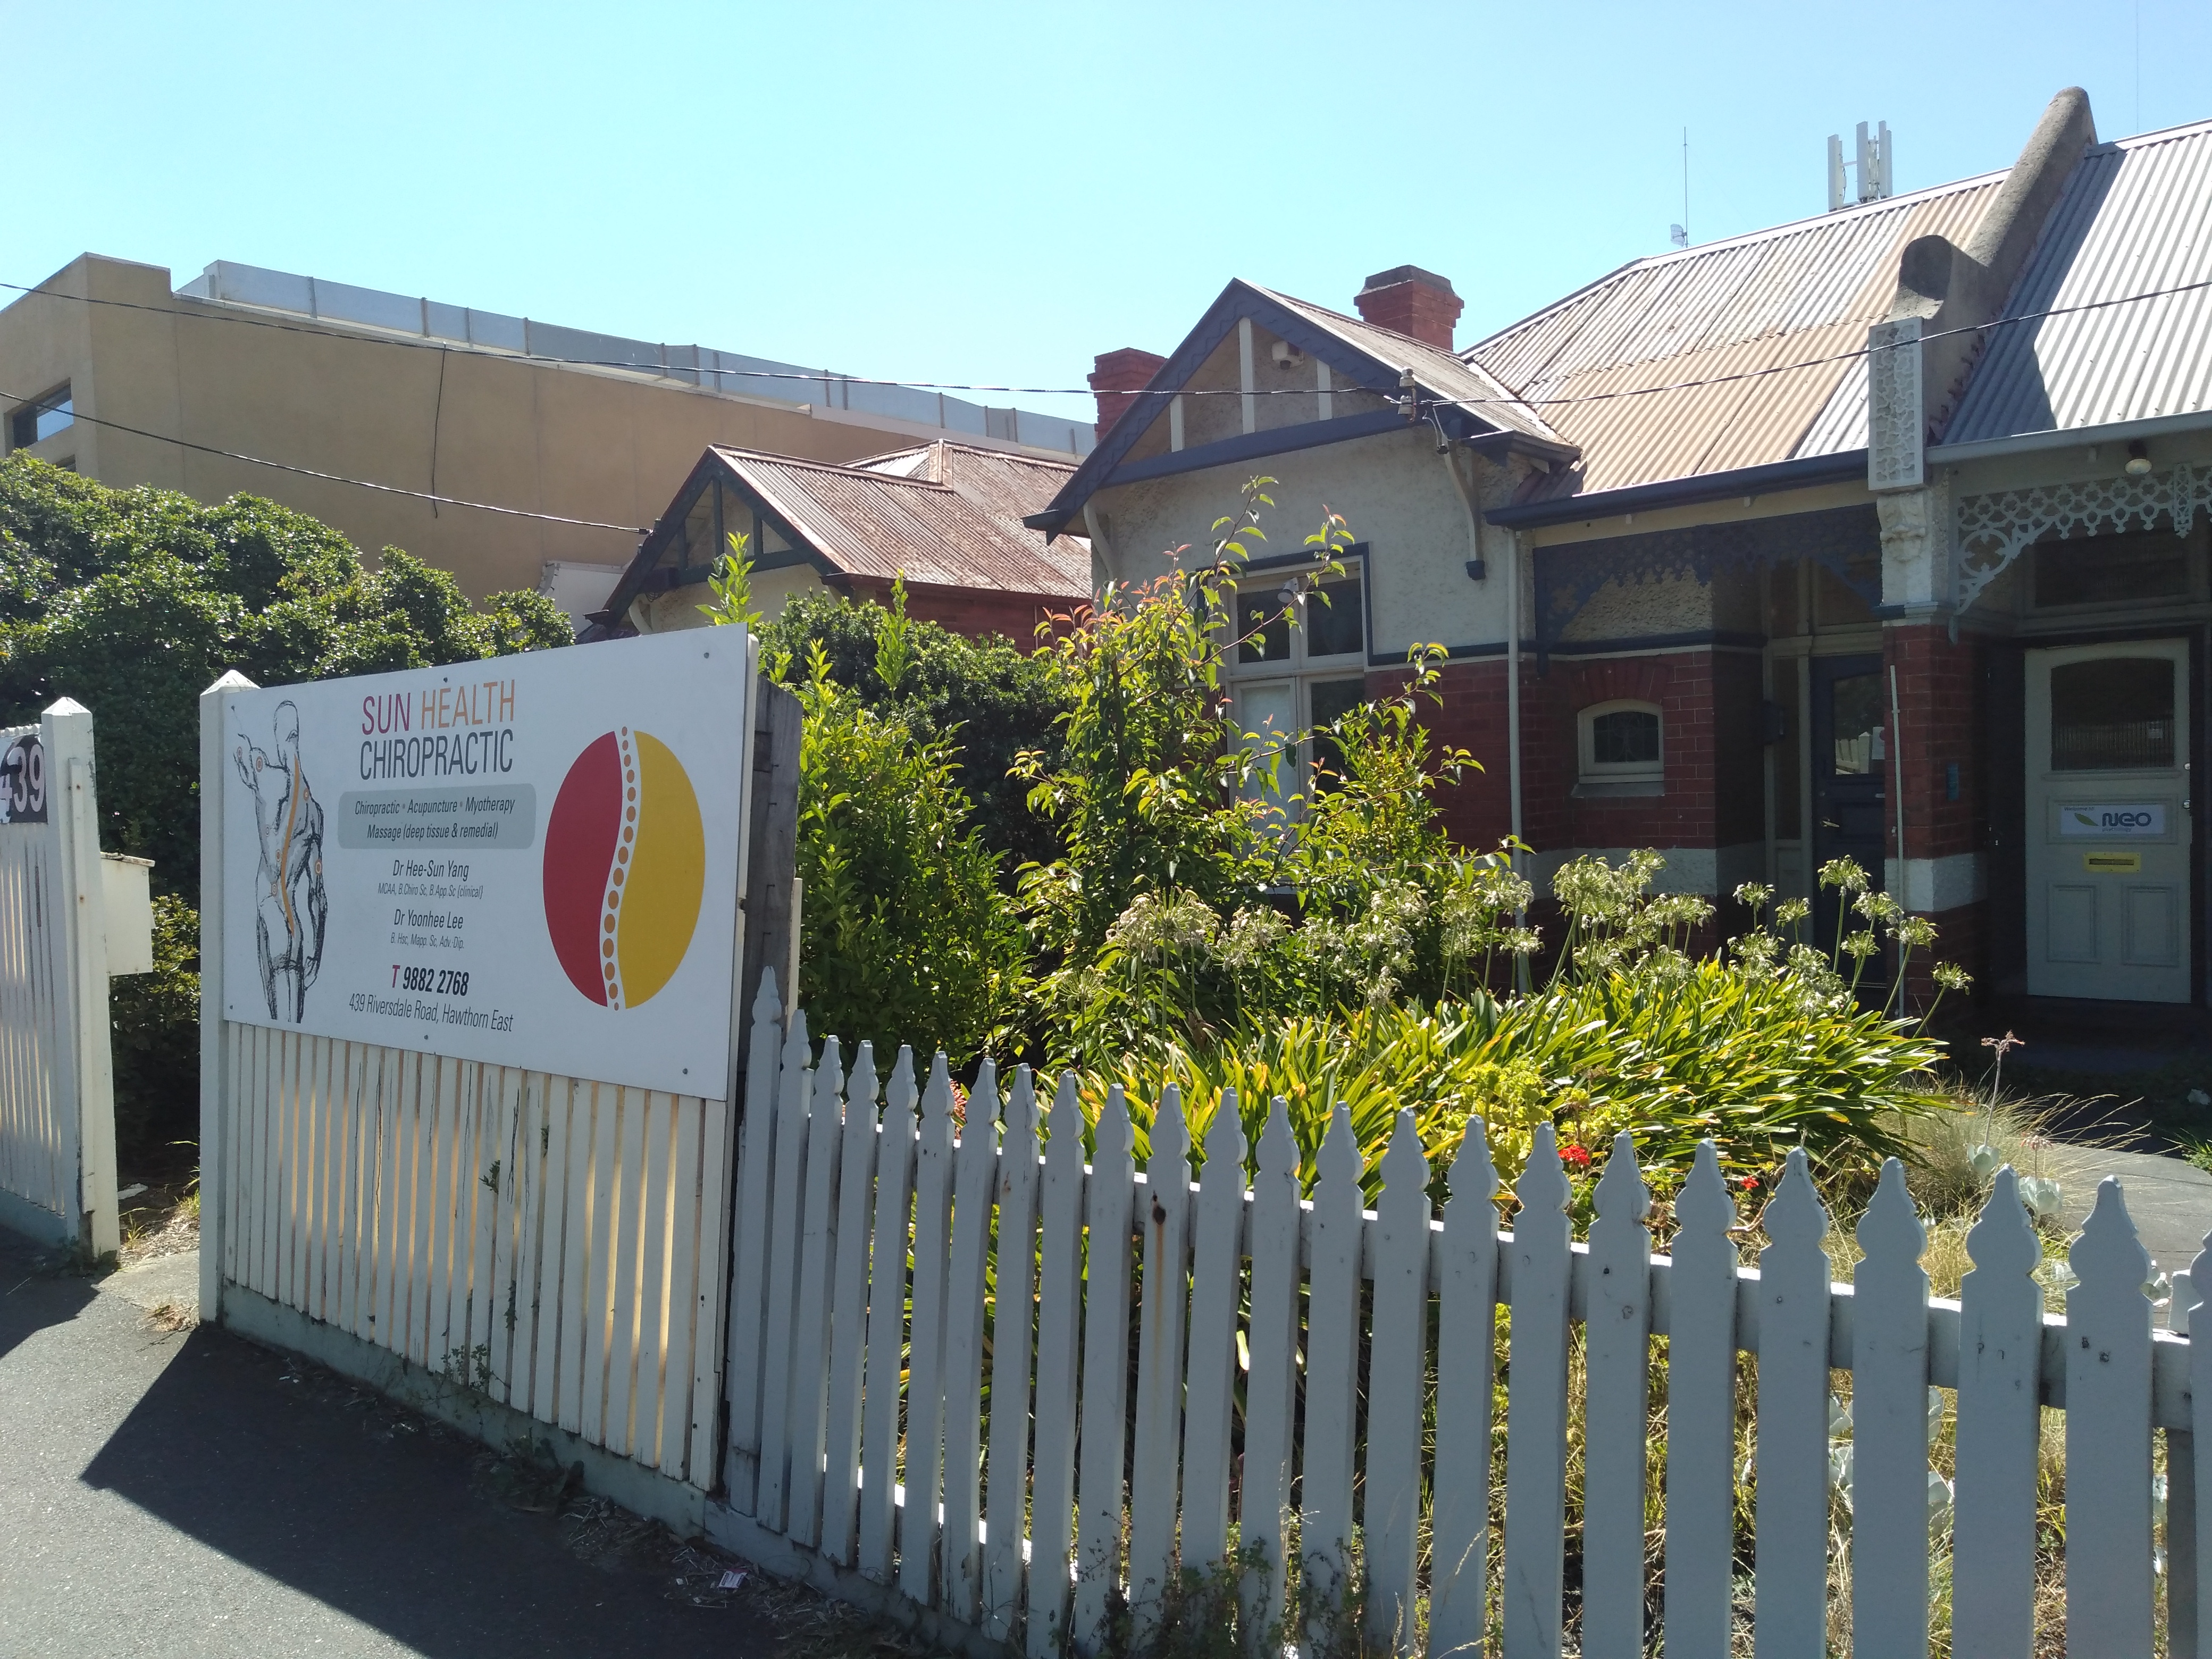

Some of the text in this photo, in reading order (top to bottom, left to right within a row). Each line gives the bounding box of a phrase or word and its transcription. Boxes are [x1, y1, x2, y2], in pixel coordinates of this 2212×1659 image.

[362, 679, 515, 735] SUN HEALTH
[360, 728, 514, 781] CHIROPRACTIC
[355, 796, 515, 817] Chiropractic Acupuncture Myotherapy
[367, 822, 499, 842] Massage (deep tissue & remedial)
[392, 859, 470, 882] Dr Hee-Sun Yang
[378, 882, 397, 895] MCAA,
[394, 909, 464, 929] Dr Yoonhee Lee
[392, 965, 470, 996] T 9882 2768
[349, 993, 514, 1032] 439 Riversdale Road, Hawthorn East
